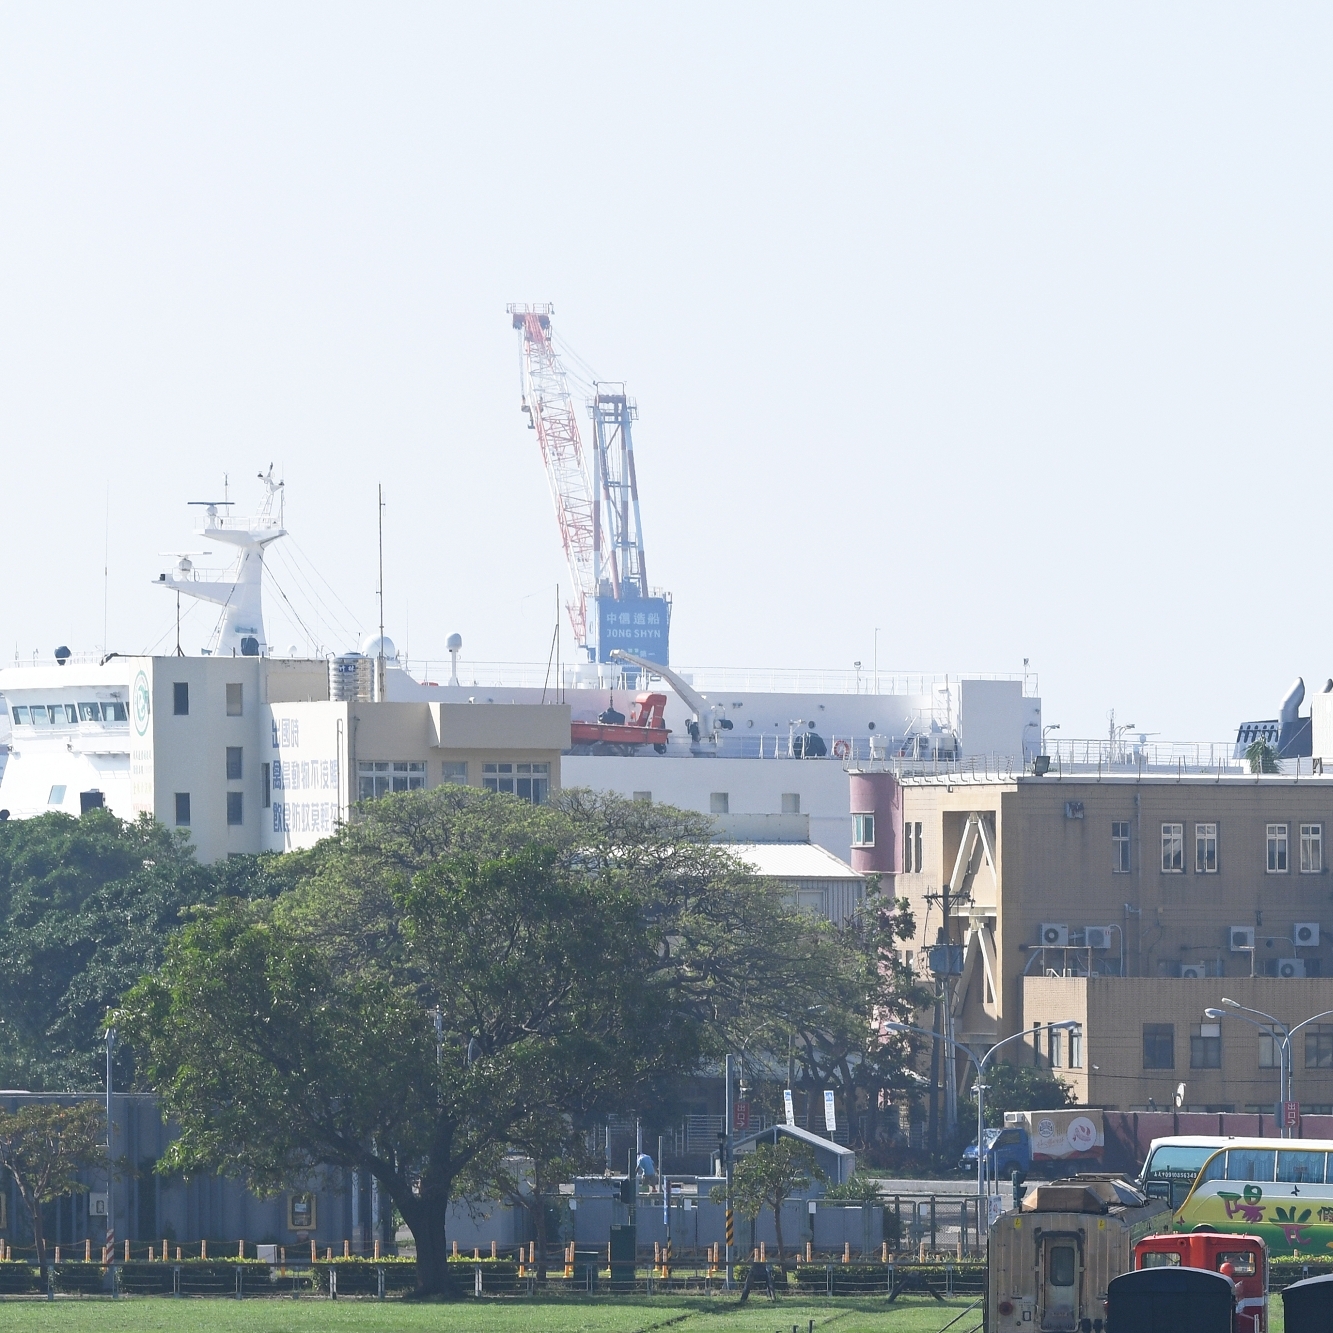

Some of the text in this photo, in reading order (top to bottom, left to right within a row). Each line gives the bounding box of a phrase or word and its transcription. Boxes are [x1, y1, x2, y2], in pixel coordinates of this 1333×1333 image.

[606, 612, 660, 625] 中信造船
[606, 628, 661, 638] JONG SHYN
[271, 718, 299, 749] 出國時
[737, 1104, 746, 1120] 出口
[1287, 1103, 1296, 1119] 出口
